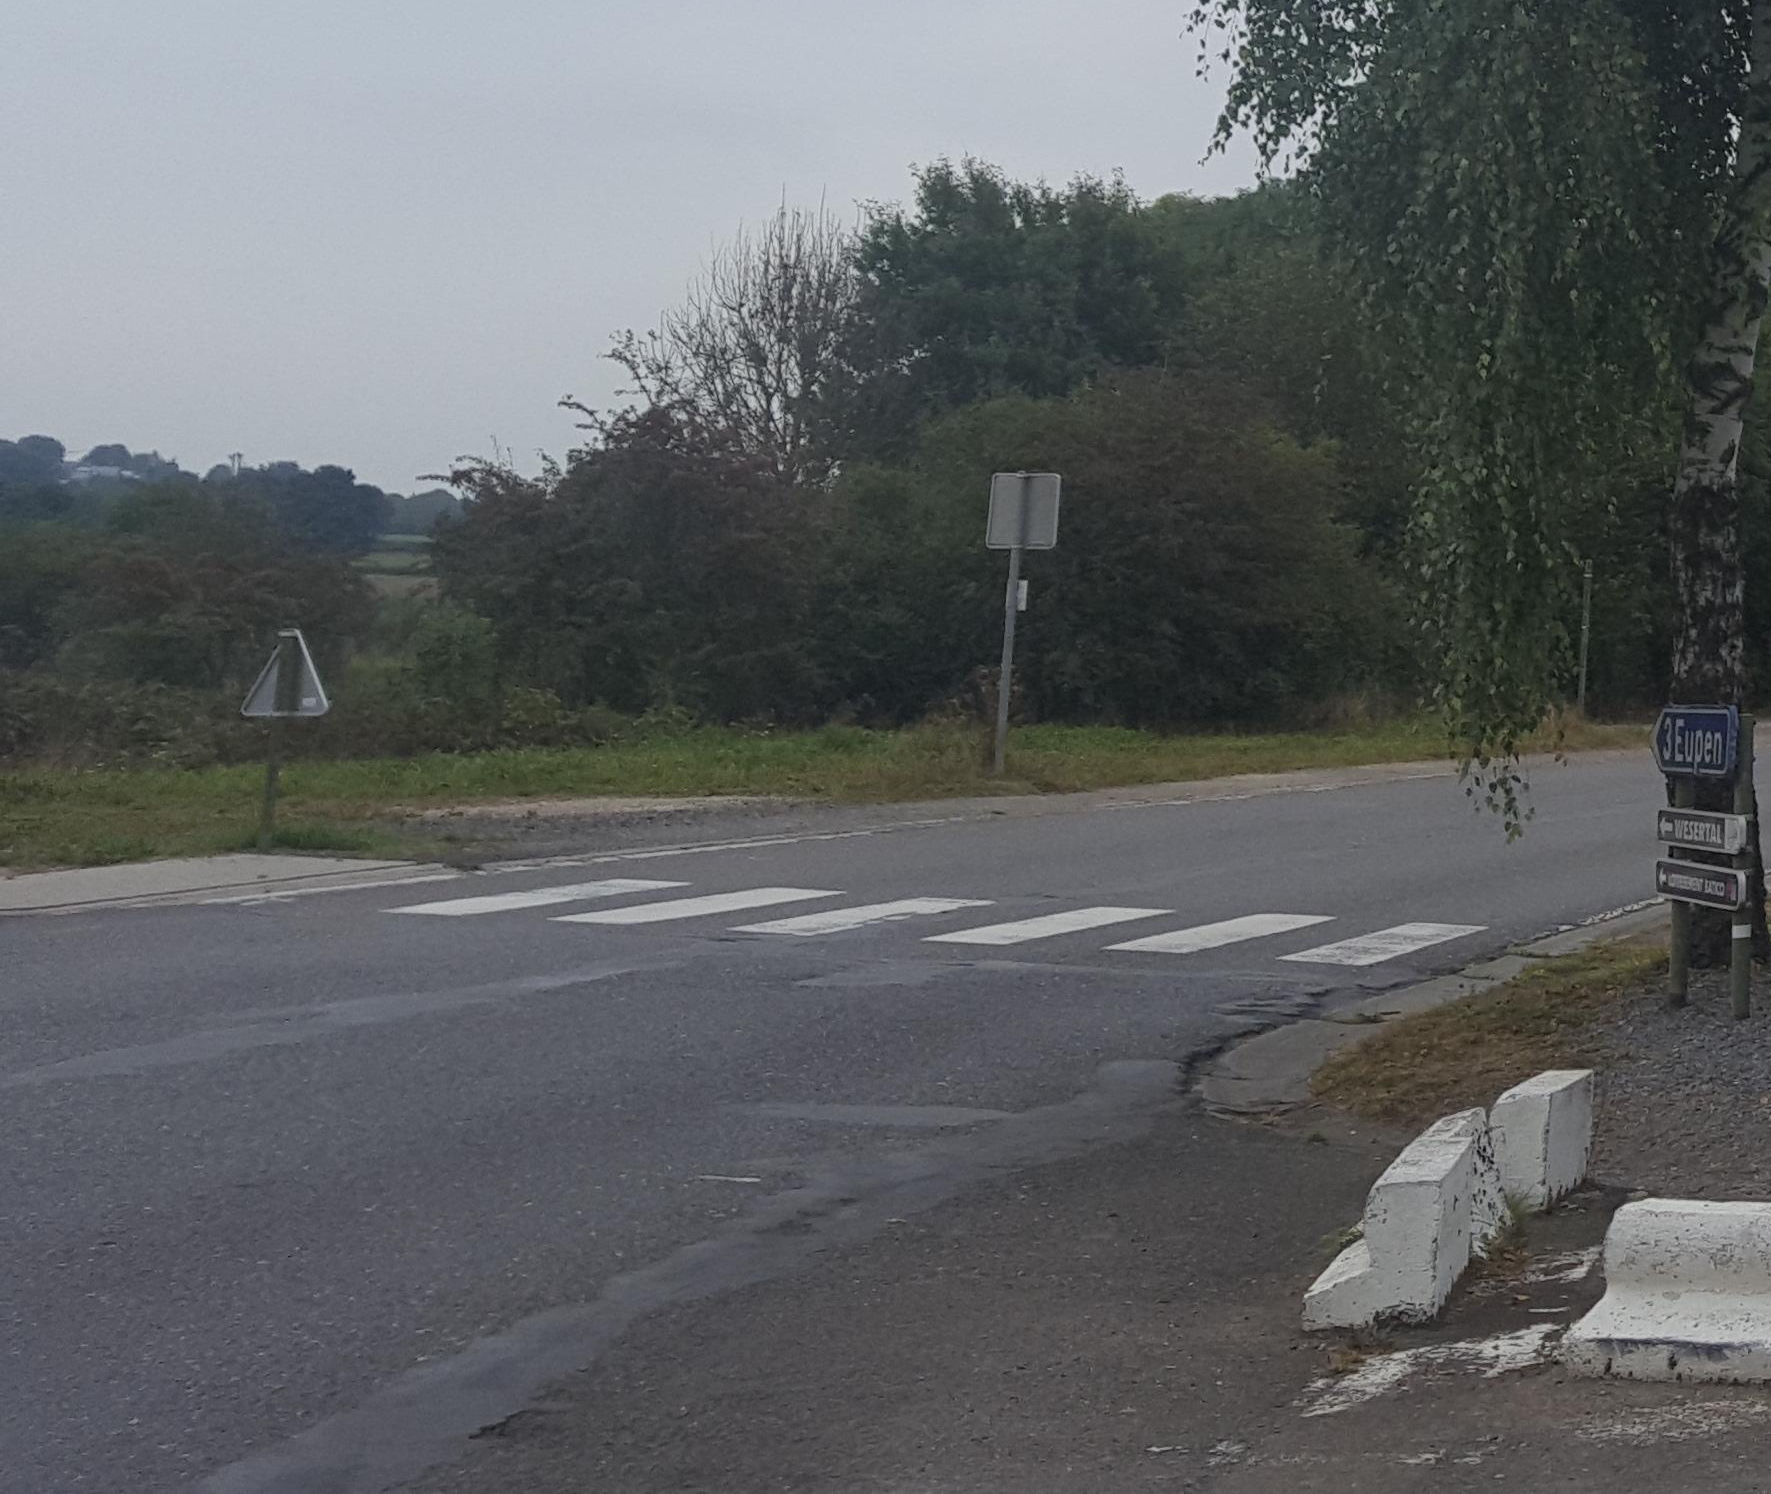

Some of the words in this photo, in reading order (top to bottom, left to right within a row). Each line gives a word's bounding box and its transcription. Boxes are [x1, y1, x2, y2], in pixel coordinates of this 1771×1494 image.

[1663, 716, 1672, 761] 3
[1674, 718, 1722, 774] Eupen
[1674, 819, 1722, 844] WESERTAL
